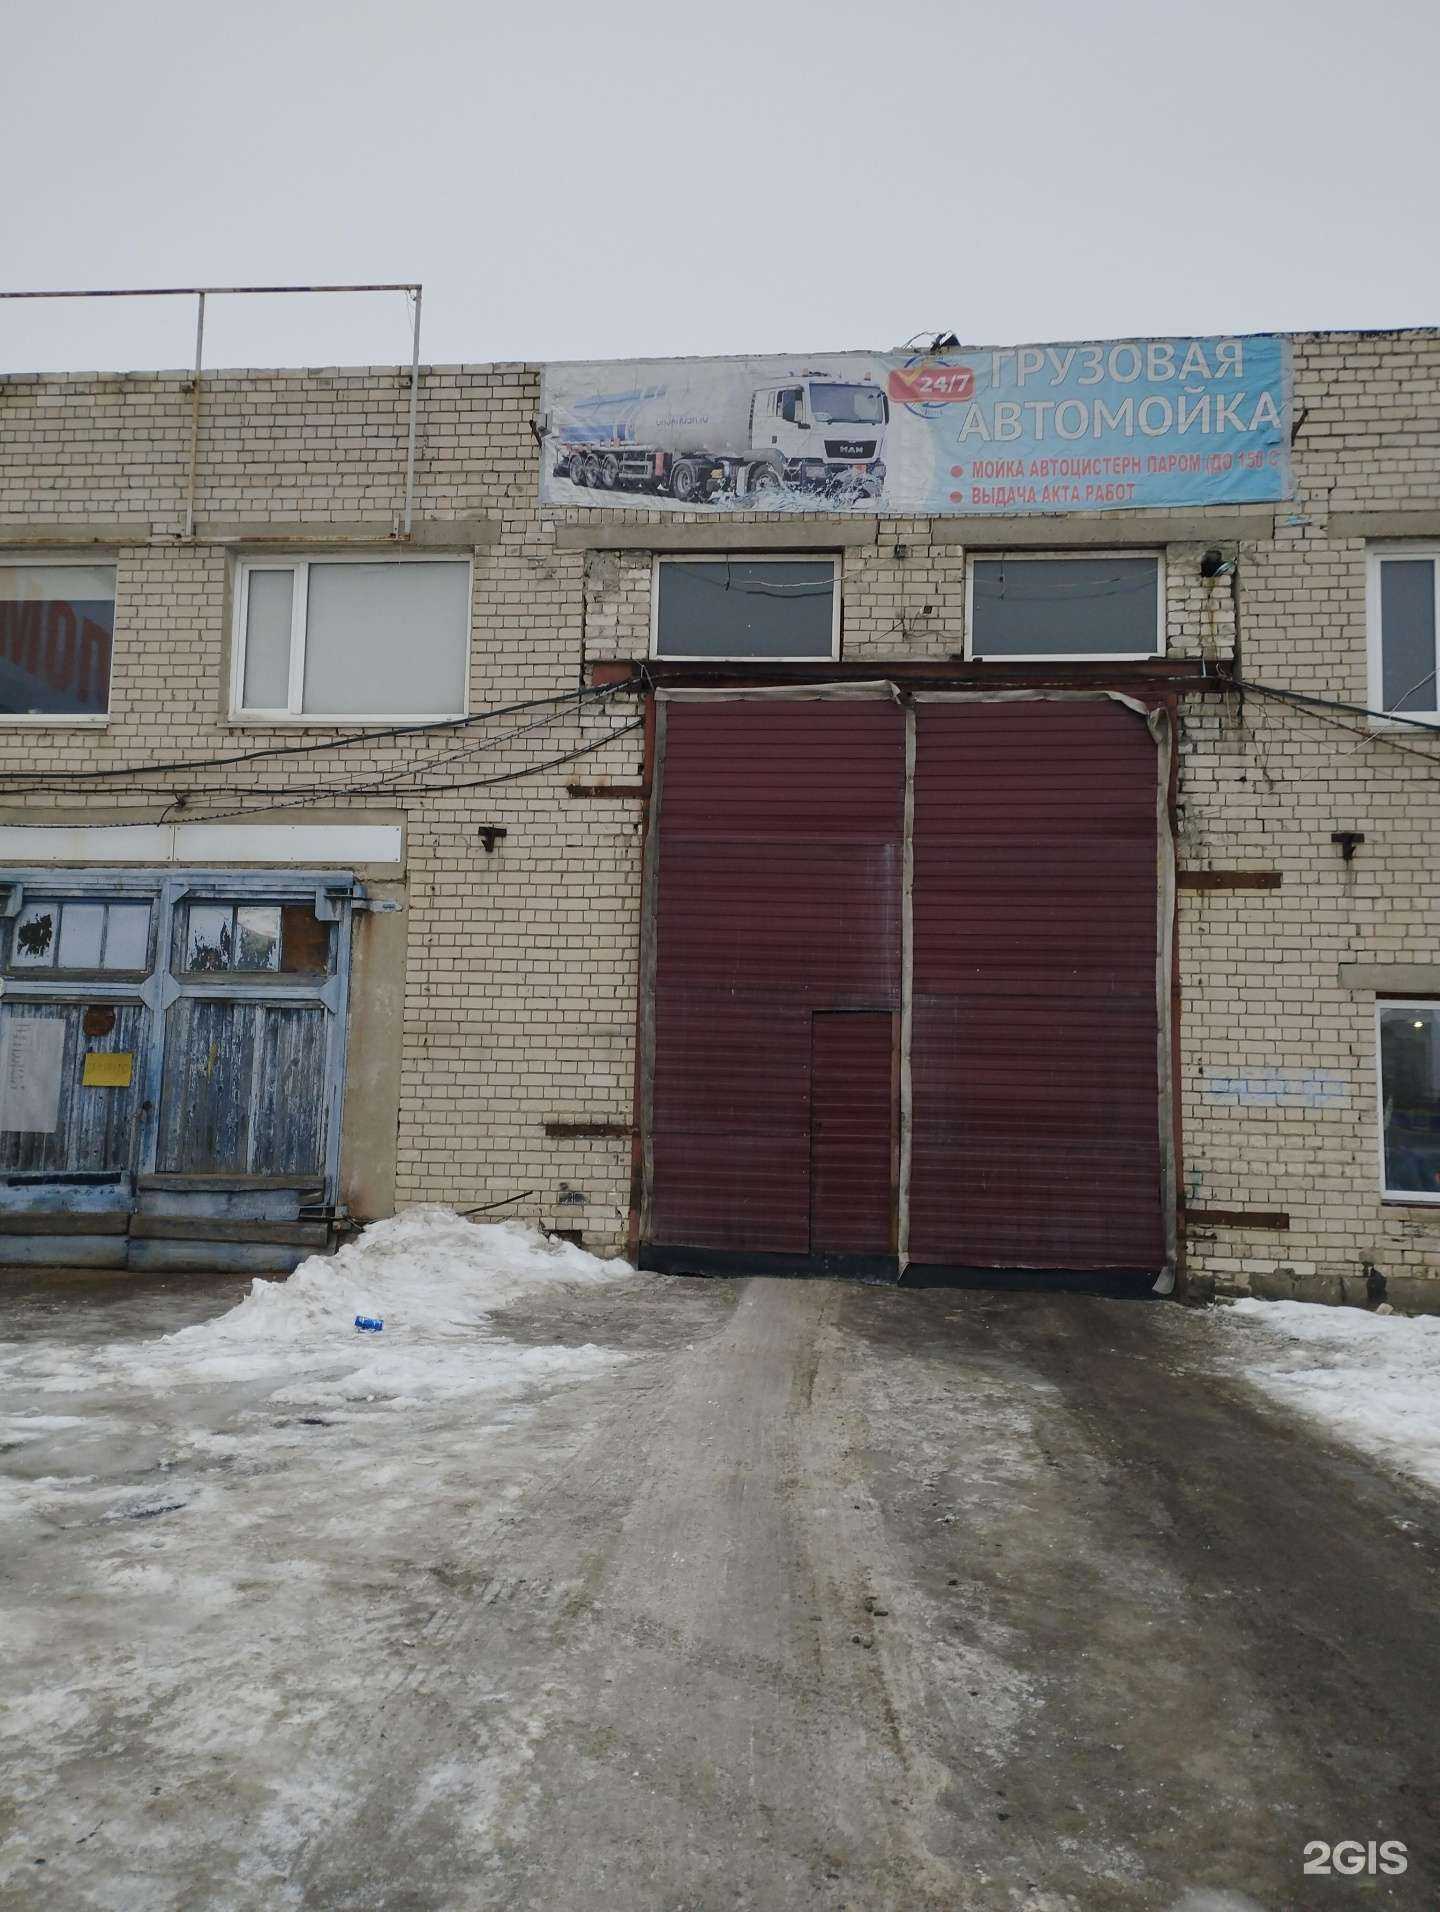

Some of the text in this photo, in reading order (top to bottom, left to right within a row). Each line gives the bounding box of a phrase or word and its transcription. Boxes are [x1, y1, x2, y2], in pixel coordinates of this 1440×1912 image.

[991, 339, 1244, 388] ГРУЗОВАЯ
[919, 374, 970, 393] 24/7
[957, 385, 1282, 443] АВТОМОЙКА
[1029, 455, 1141, 479] АВТОЦИСТЕРН
[1148, 453, 1200, 473] ПАРОМ
[972, 482, 1135, 507] ВЫДАЧА АКТА РАБОТ
